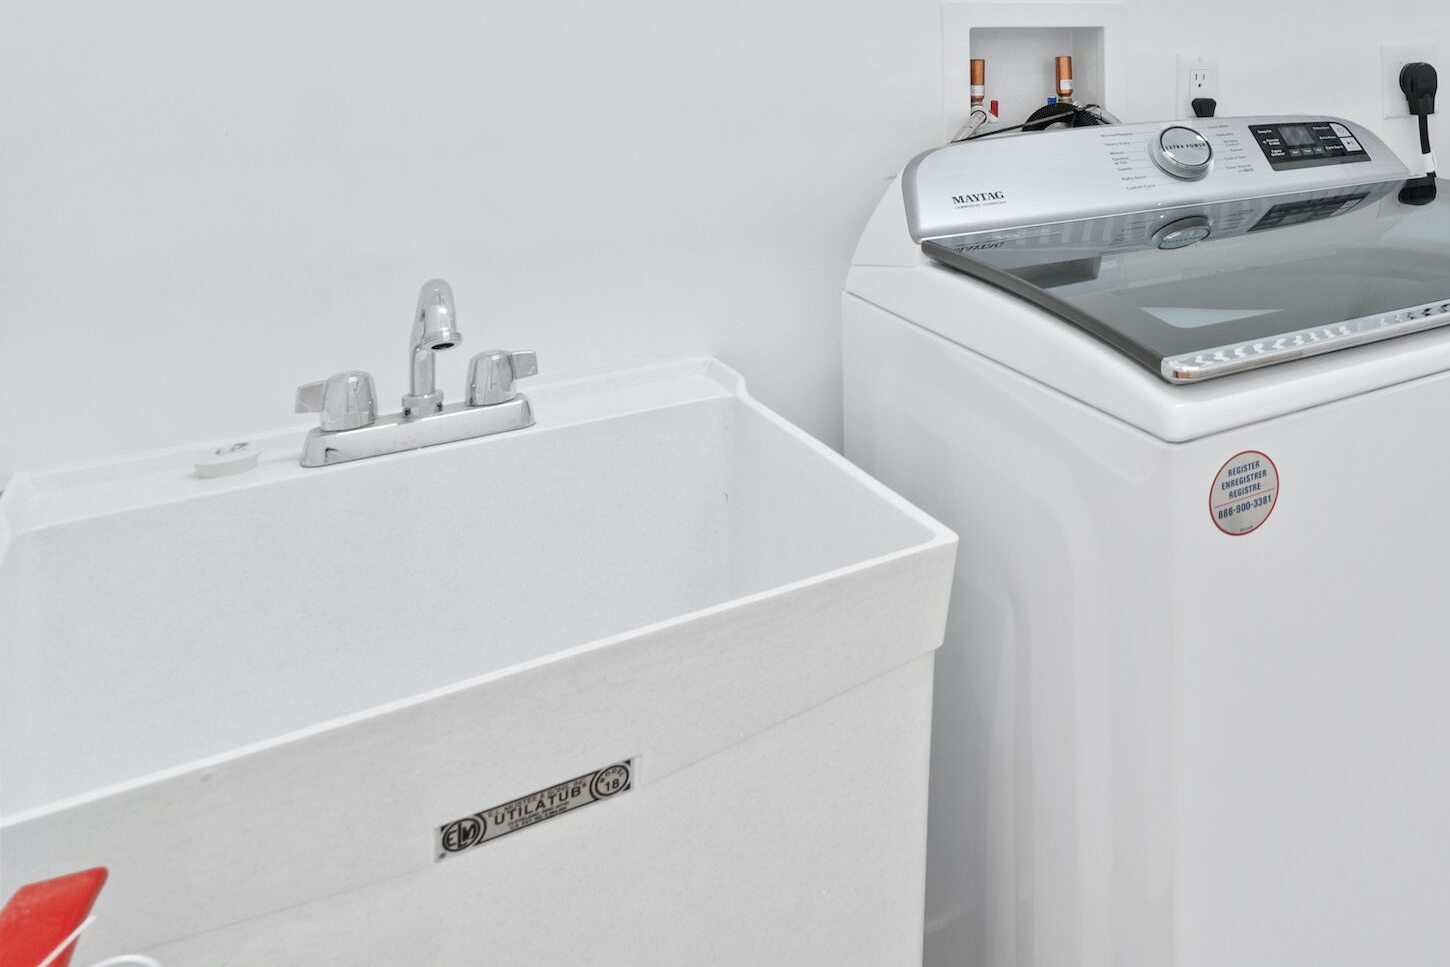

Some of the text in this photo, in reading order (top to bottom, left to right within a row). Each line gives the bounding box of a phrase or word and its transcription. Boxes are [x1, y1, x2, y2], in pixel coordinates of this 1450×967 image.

[952, 191, 1004, 204] MAYTAG
[1228, 460, 1260, 477] REGISTER
[1221, 469, 1267, 490] ENREGISTRER
[1228, 482, 1261, 499] REGISTRE
[1218, 494, 1272, 520] 888-900-3381
[604, 778, 620, 792] 18
